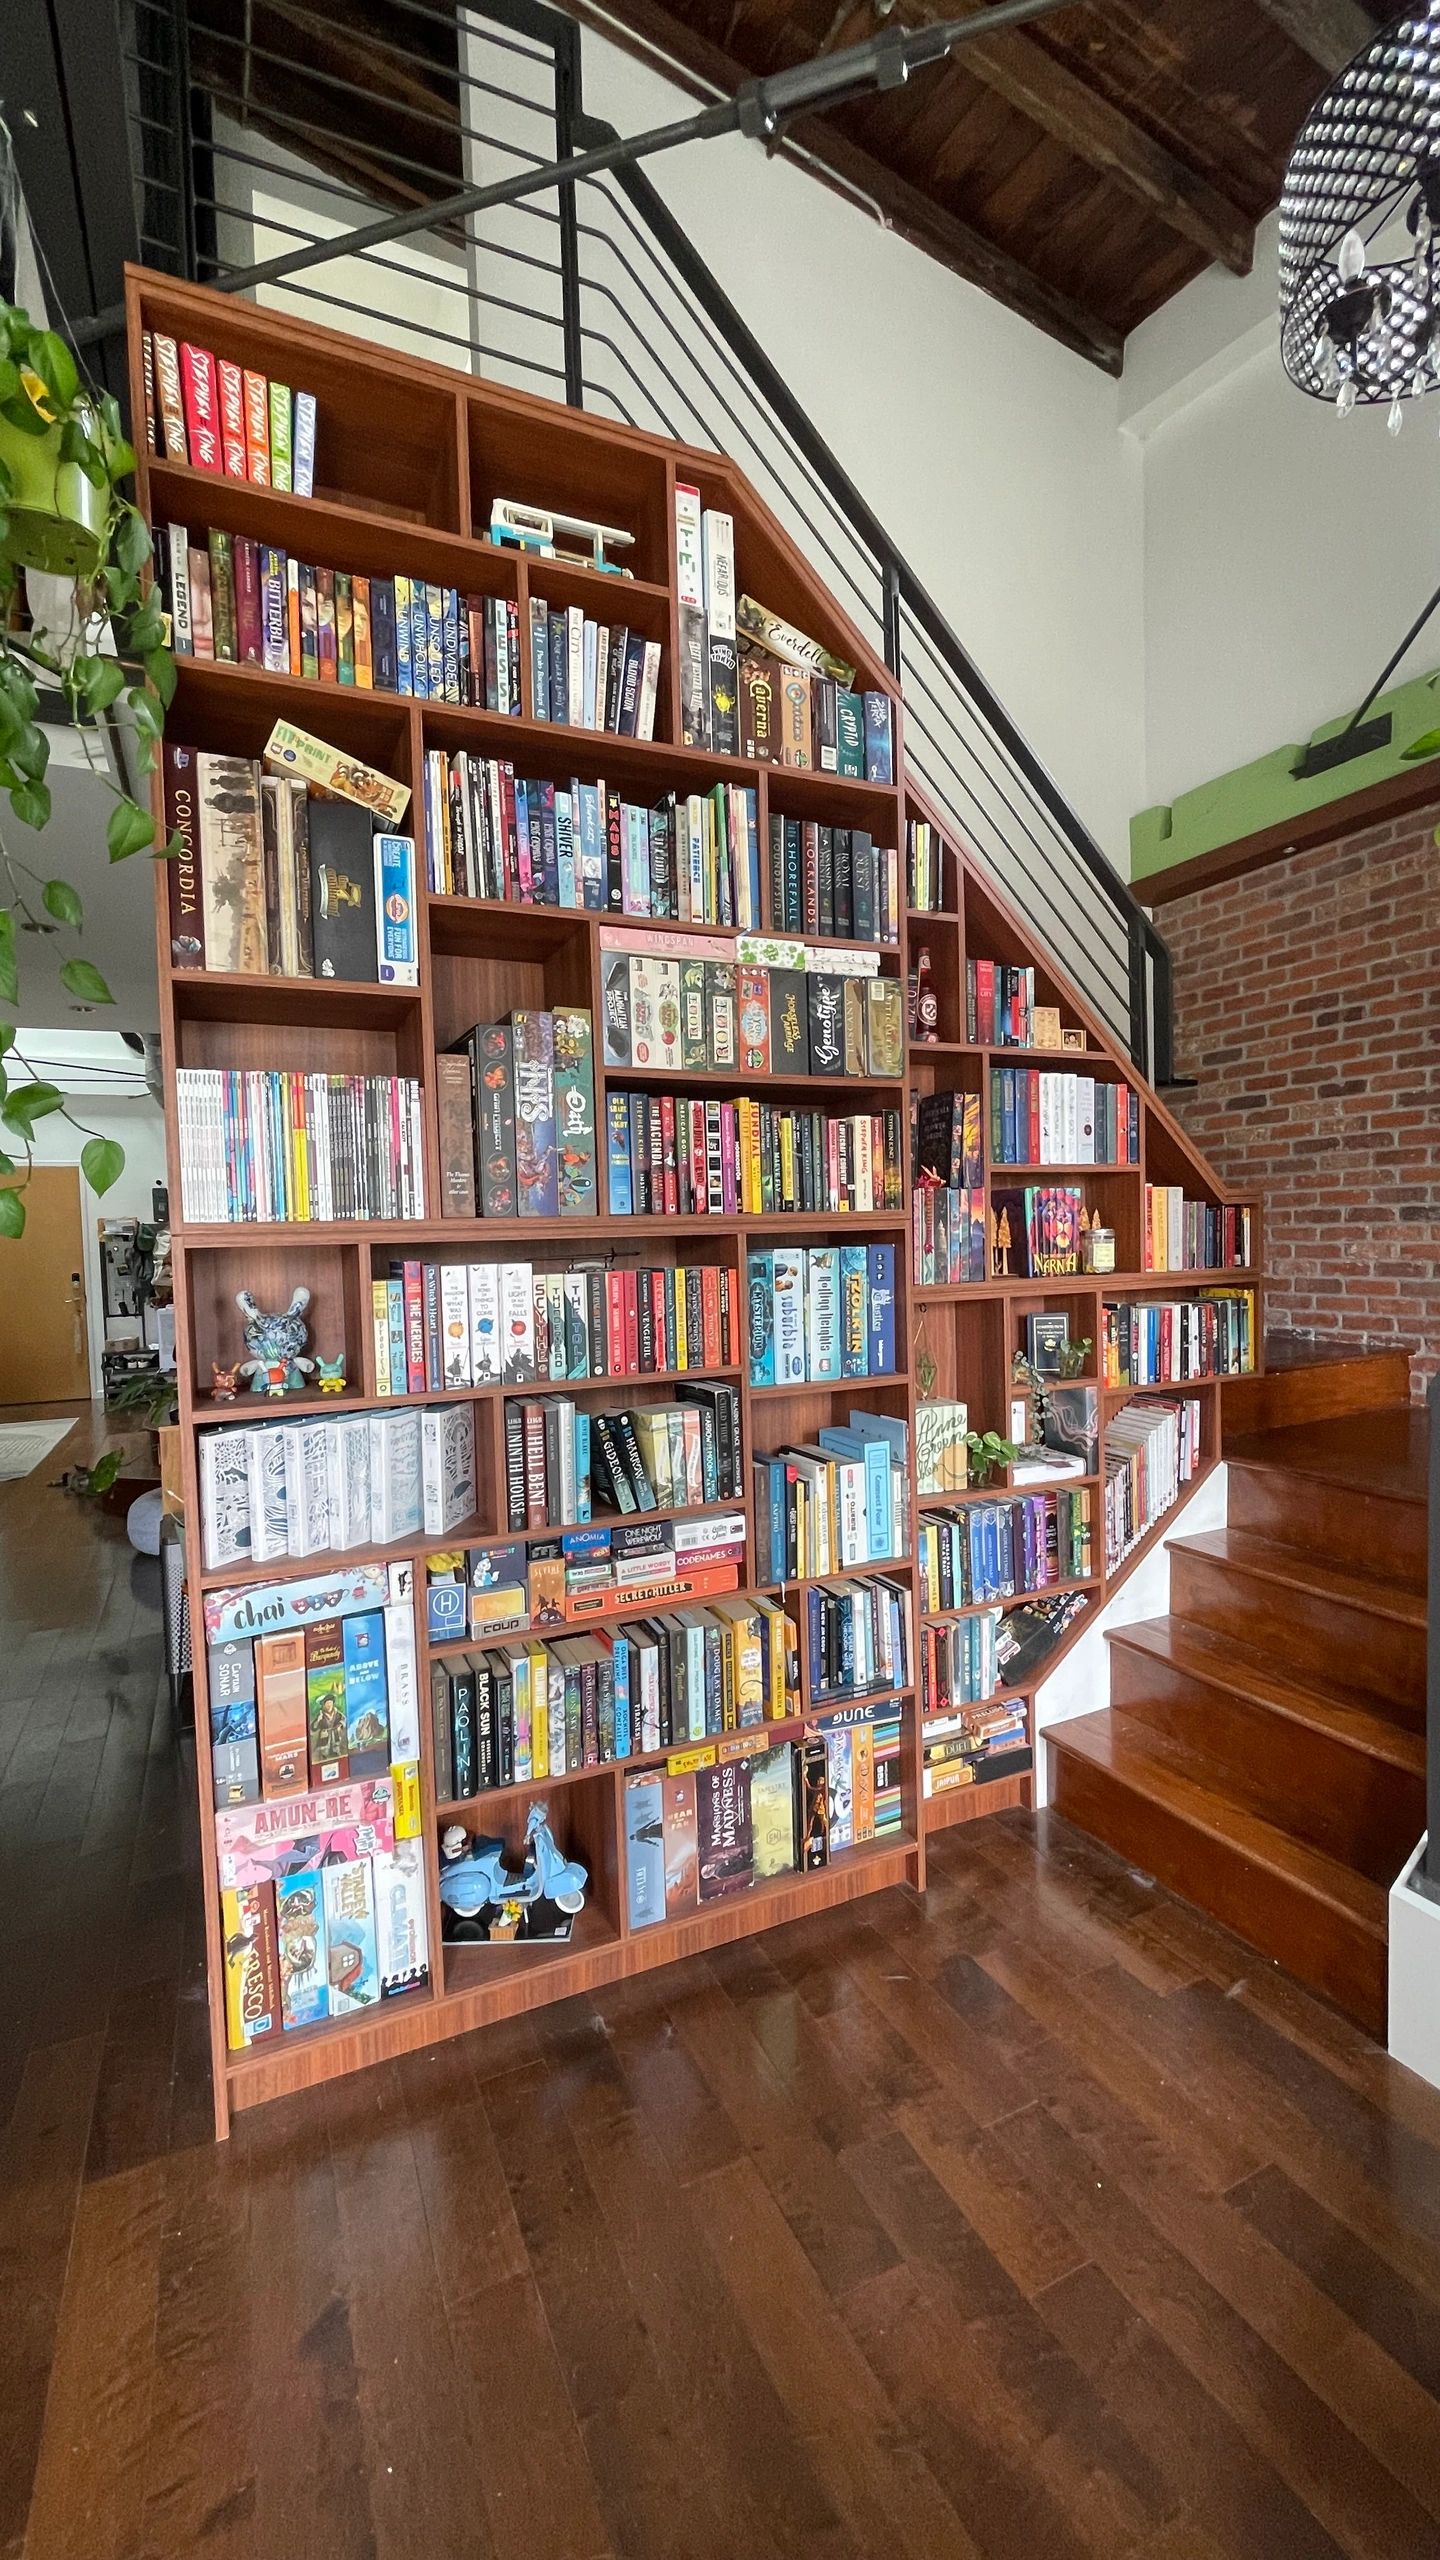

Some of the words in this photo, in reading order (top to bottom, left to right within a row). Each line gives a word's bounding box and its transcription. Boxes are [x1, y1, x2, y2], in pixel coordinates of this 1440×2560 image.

[154, 332, 179, 407] STEPHEN
[186, 343, 211, 420] STEPHEN
[219, 360, 241, 433] STEPHEN
[244, 370, 266, 443] STEPHEN
[270, 382, 290, 451] STEPHEN
[163, 416, 184, 452] KING
[189, 426, 215, 463] KING
[297, 393, 315, 460] STEPHEN
[224, 440, 243, 476] KING
[248, 450, 268, 485] KING
[272, 461, 290, 491] KING
[716, 554, 728, 596] NEFARIOUS
[176, 572, 187, 629] LEGEND
[397, 611, 409, 662] UNWIND
[414, 614, 427, 684] UNWHOLLY
[429, 618, 442, 683] UNSOULED
[445, 620, 458, 689] UNDIVIDED
[497, 609, 508, 698] LESS
[766, 620, 824, 665] Everdell
[627, 659, 638, 686] BLOOD
[623, 688, 636, 712] SCION
[749, 680, 772, 739] Caverna
[840, 708, 859, 747] CRYPTID
[296, 737, 332, 764] PRINT
[558, 817, 573, 858] SHIVER
[584, 794, 597, 844] Blankets
[609, 810, 619, 856] MAUS
[393, 842, 401, 867] CREATE
[692, 837, 700, 883] PATIENCE
[773, 837, 782, 918] FOUNDRYSIDE
[788, 842, 797, 921] SHOREFALL
[806, 841, 816, 924] LOCKLANDS
[394, 928, 402, 943] FUN
[394, 945, 402, 958] FOR
[646, 933, 694, 946] WINGSPAN
[689, 994, 698, 1038] ROOT
[715, 999, 729, 1061] ROOT
[785, 994, 801, 1040] HORSELESS
[815, 986, 840, 1065] Genotype
[562, 1086, 592, 1137] Oath
[750, 1105, 759, 1158] SUNDIAL
[651, 1120, 662, 1166] HACIENDA
[1034, 1254, 1078, 1274] NARNA
[411, 1297, 420, 1317] THE
[572, 1286, 582, 1318] THE
[754, 1291, 763, 1350] MYSTERIUM
[781, 1295, 797, 1349] suburbia
[411, 1321, 423, 1363] MERCIES
[535, 1284, 548, 1362] SCYTHE
[642, 1310, 650, 1358] VENGEFUL
[509, 1435, 523, 1472] NINTH
[528, 1436, 543, 1470] HELL
[625, 1437, 644, 1480] HARROW
[510, 1475, 525, 1515] HOUSE
[529, 1472, 544, 1507] BENT
[569, 1533, 605, 1543] ANOMIA
[625, 1527, 640, 1537] ONE
[641, 1524, 662, 1534] NIGHT
[625, 1534, 662, 1545] WEREWOLF
[627, 1564, 646, 1572] LITTLE
[648, 1560, 670, 1568] WORDY
[677, 1551, 726, 1566] CODENAMES
[234, 1596, 285, 1630] chai
[615, 1590, 649, 1604] SECRET
[650, 1582, 686, 1598] HITLER
[484, 1620, 519, 1634] COUP
[219, 1664, 231, 1697] SONAR
[231, 1663, 242, 1694] CAPTAIN
[349, 1659, 379, 1671] ABOVE
[349, 1673, 379, 1685] BELOW
[400, 1663, 409, 1706] BRASS
[713, 1649, 721, 1690] DOUGLAS
[479, 1672, 489, 1711] BLACK
[458, 1688, 471, 1781] PAOLINI
[480, 1711, 490, 1736] SUN
[570, 1715, 578, 1730] SKY
[832, 1705, 875, 1724] DUNE
[712, 1776, 720, 1788] OF
[936, 1773, 960, 1790] JAIPUR
[254, 1795, 352, 1835] AMUN-RE
[712, 1792, 721, 1847] MANSIONS
[722, 1767, 736, 1848] MADNESS
[244, 1939, 264, 2020] FRESCO
